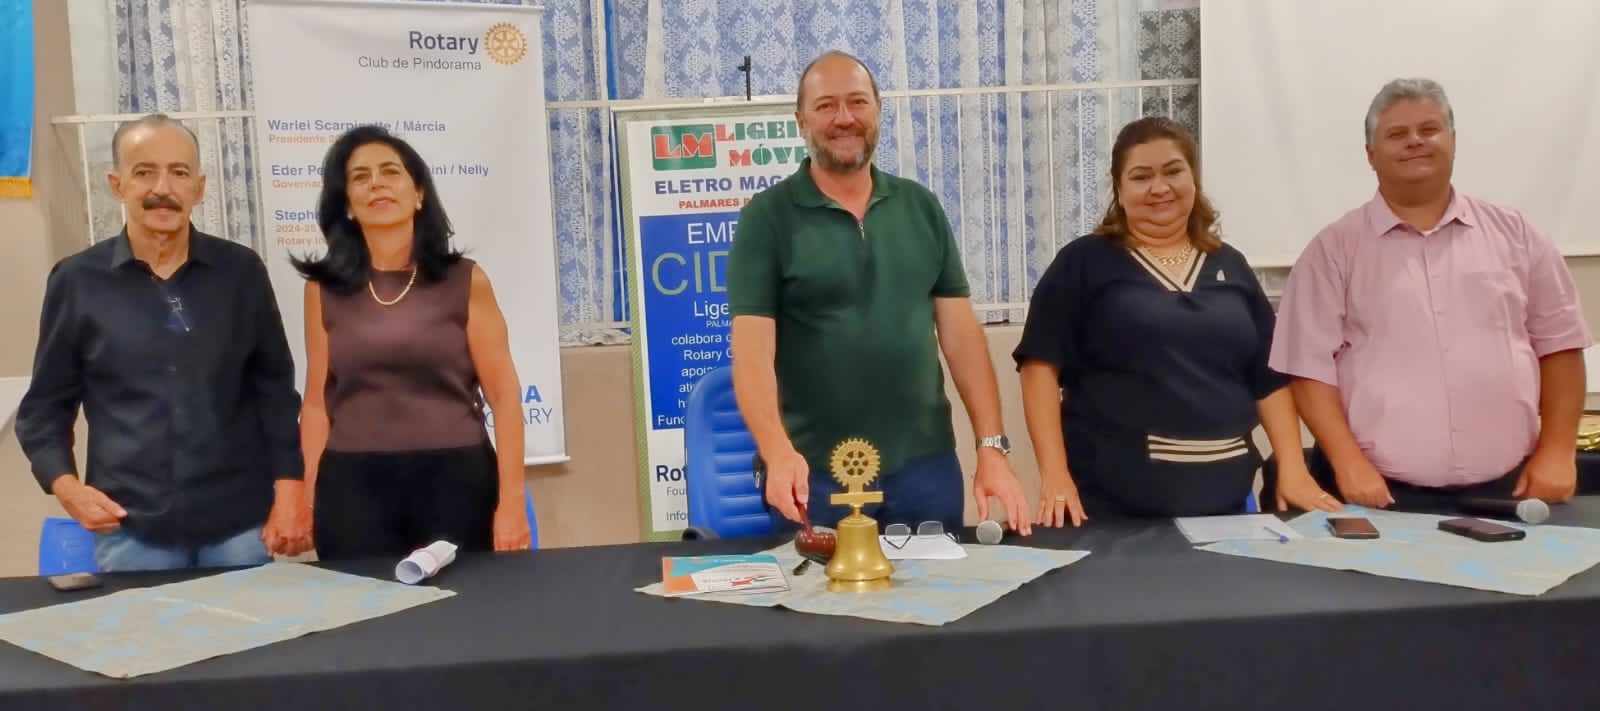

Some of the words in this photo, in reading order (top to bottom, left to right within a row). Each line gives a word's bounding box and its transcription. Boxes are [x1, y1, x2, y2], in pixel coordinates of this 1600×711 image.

[409, 30, 479, 54] Rotary
[358, 56, 388, 68] Club
[392, 58, 409, 68] de
[413, 57, 482, 71] Pindorama
[654, 133, 713, 159] LM
[271, 164, 304, 176] Eder
[458, 164, 489, 177] Nelly
[655, 177, 732, 195] ELETRO
[679, 198, 739, 209] PALMARES
[671, 333, 722, 345] colabora
[683, 348, 722, 362] Rotary
